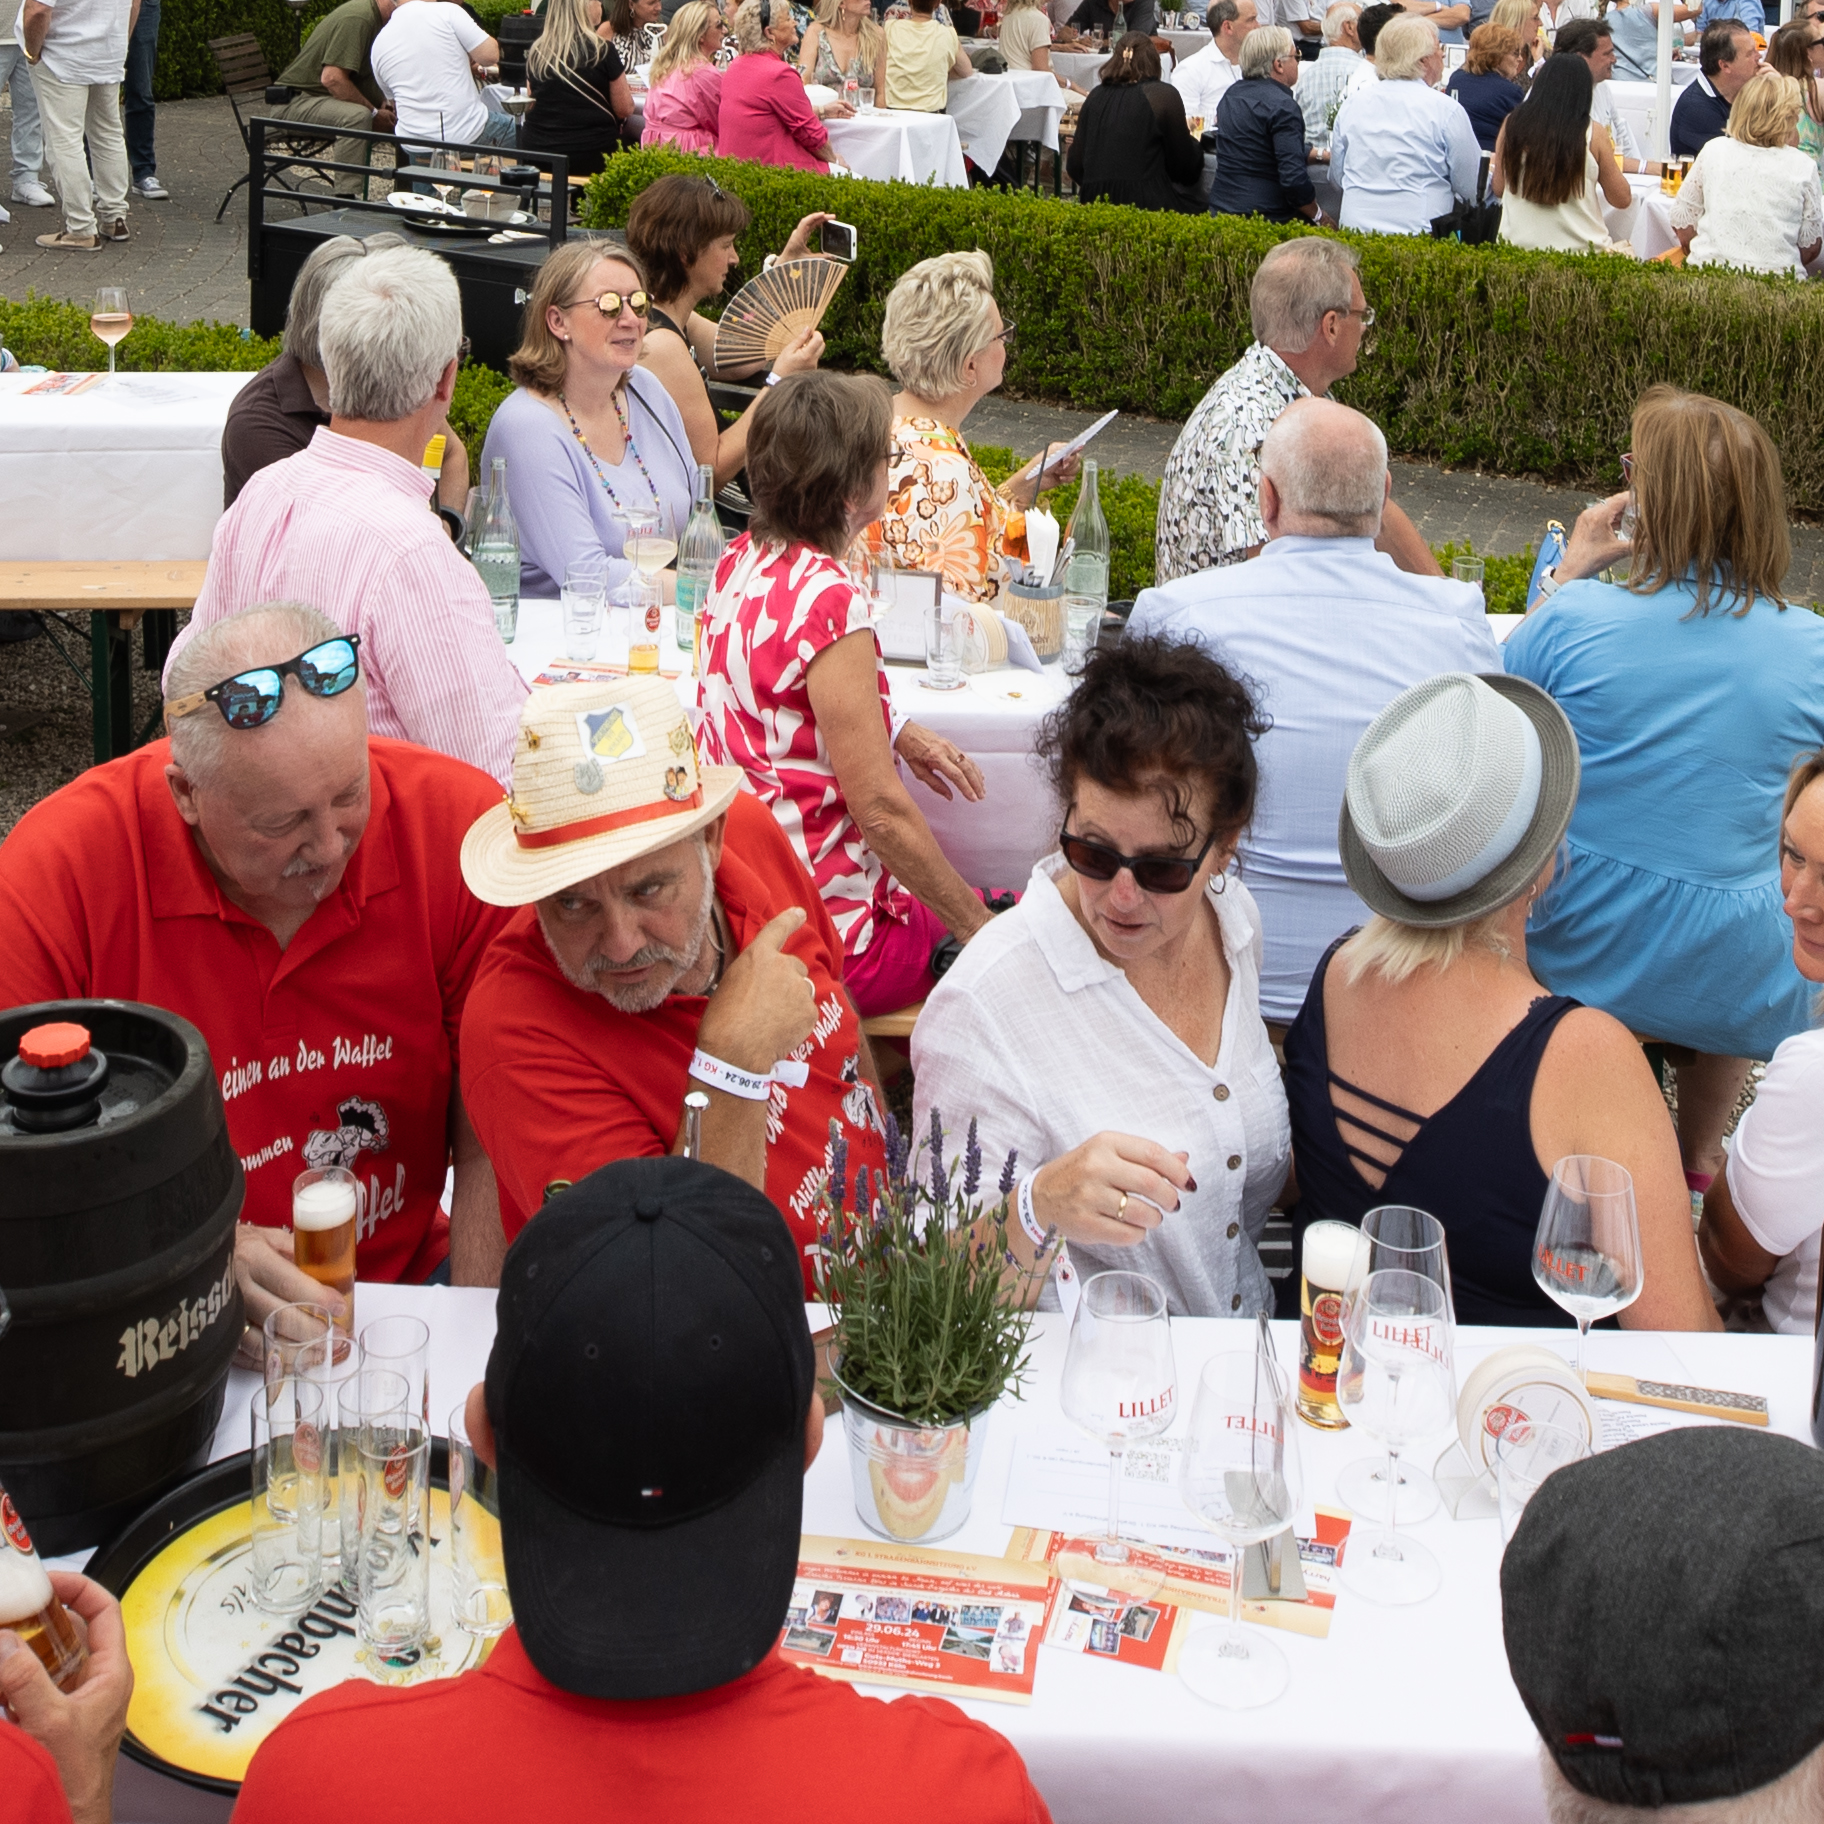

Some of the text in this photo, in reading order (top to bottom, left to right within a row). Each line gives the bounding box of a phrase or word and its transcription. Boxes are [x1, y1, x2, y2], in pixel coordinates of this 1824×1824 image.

[222, 1033, 393, 1102] einen an der Waffel
[241, 1136, 294, 1172] ommen
[116, 1252, 236, 1378] Reissd
[1119, 1385, 1174, 1418] LILLET
[865, 1622, 920, 1639] 29.06.24
